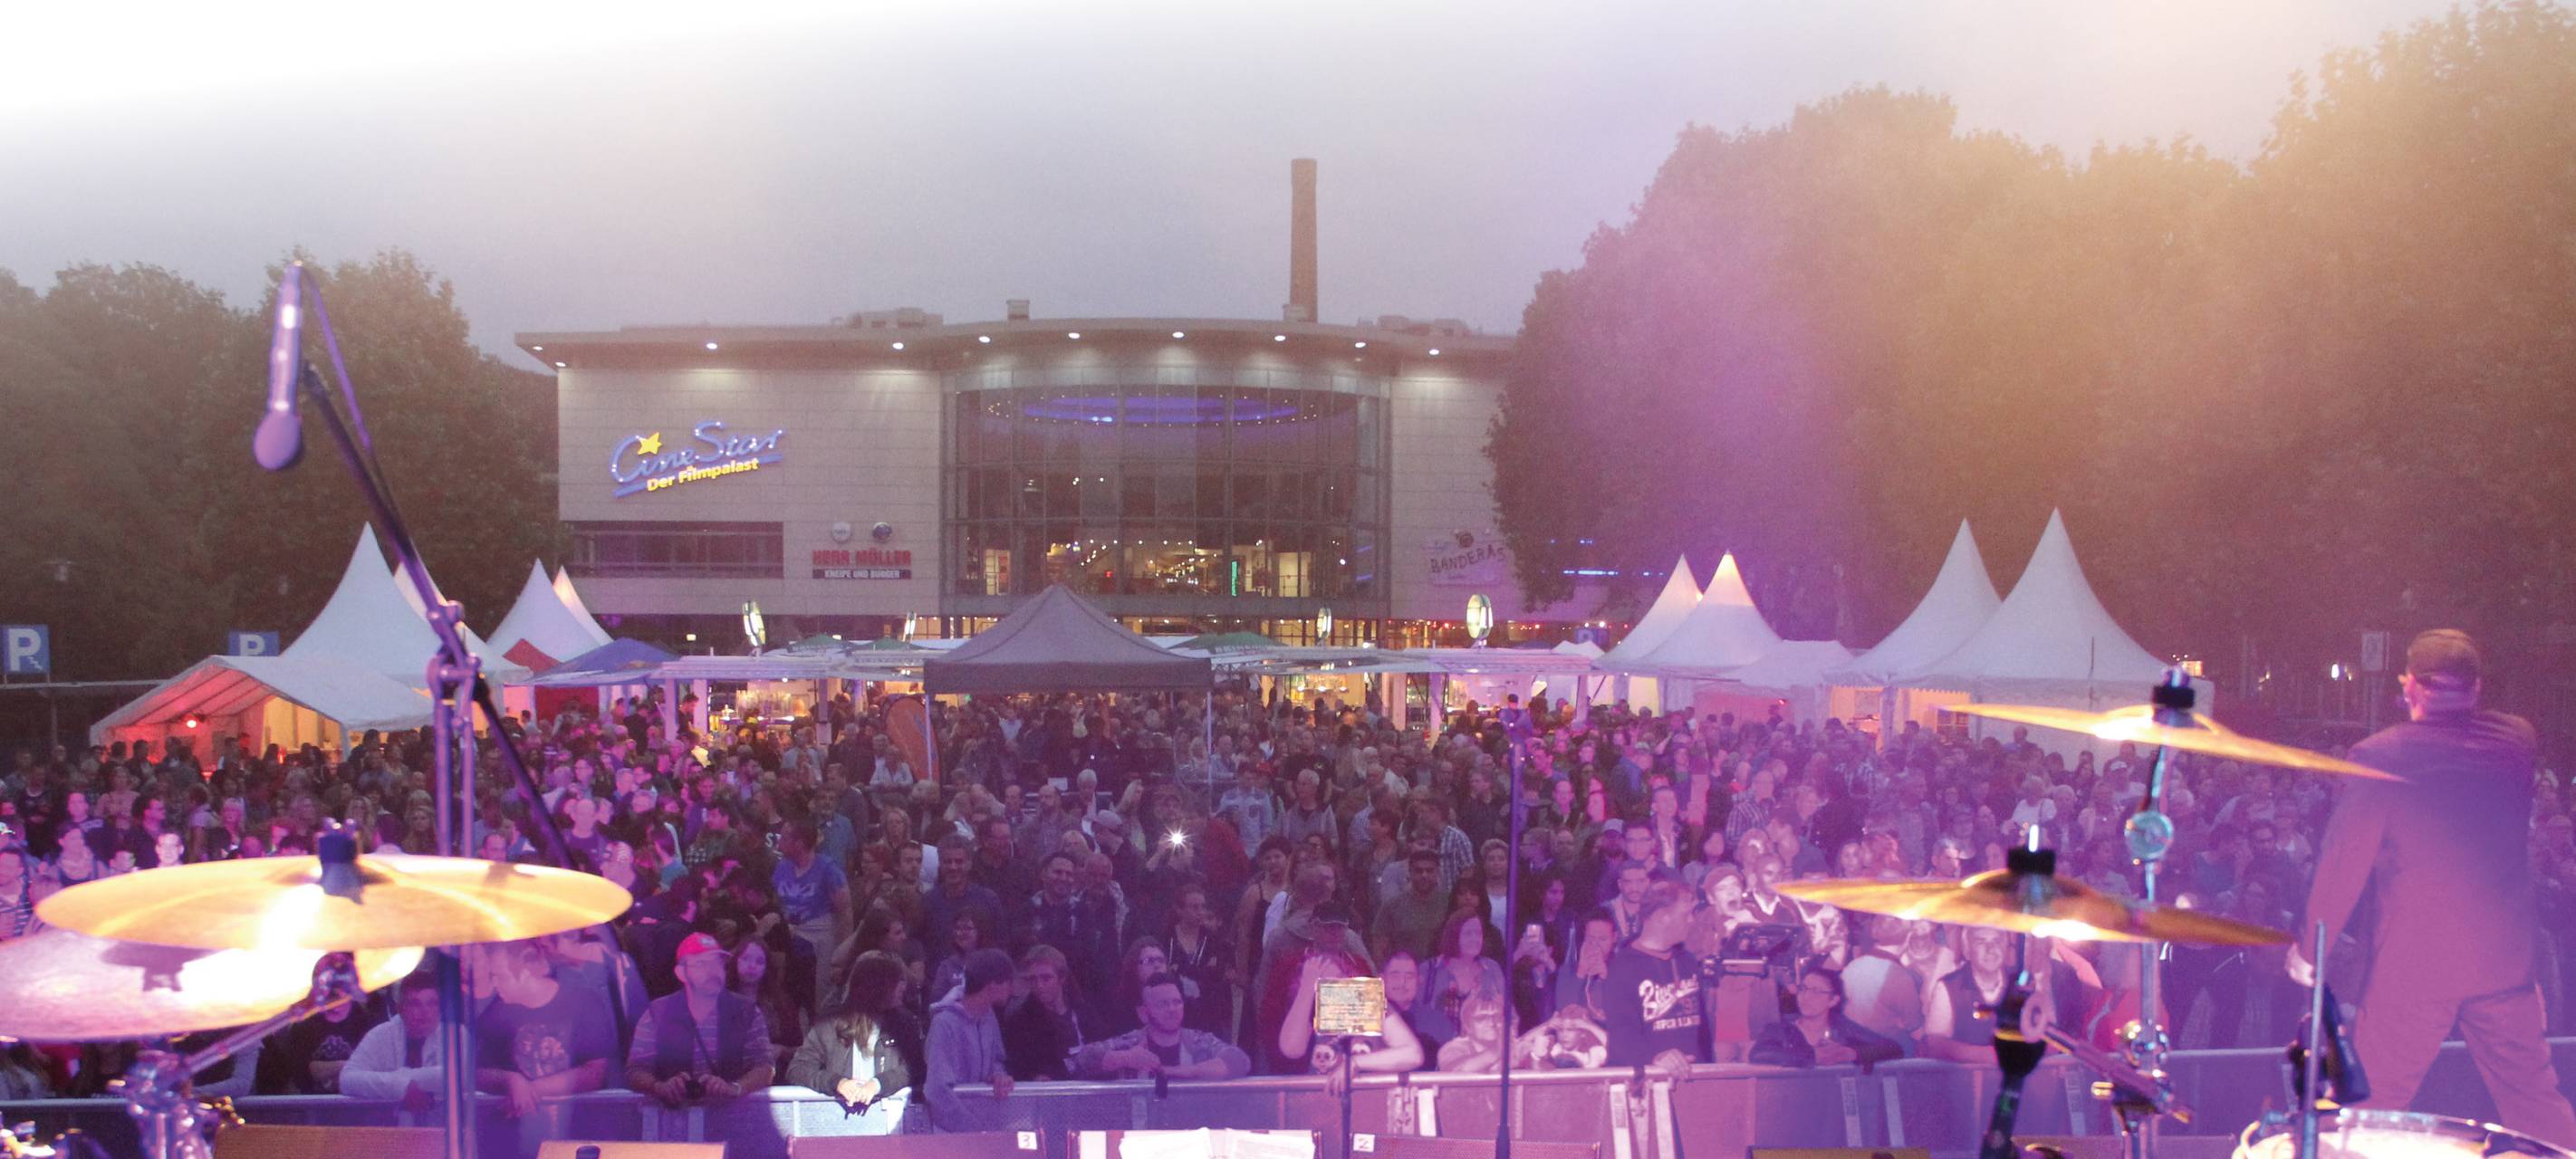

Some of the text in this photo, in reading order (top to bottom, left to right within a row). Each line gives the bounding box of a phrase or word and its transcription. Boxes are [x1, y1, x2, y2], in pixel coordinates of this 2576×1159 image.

[610, 420, 785, 483] CineStar
[647, 457, 759, 492] Der Filmpalast
[855, 547, 911, 566] MÖLLER
[1430, 544, 1506, 573] BANDERAS
[9, 627, 42, 672] P
[239, 633, 266, 656] P
